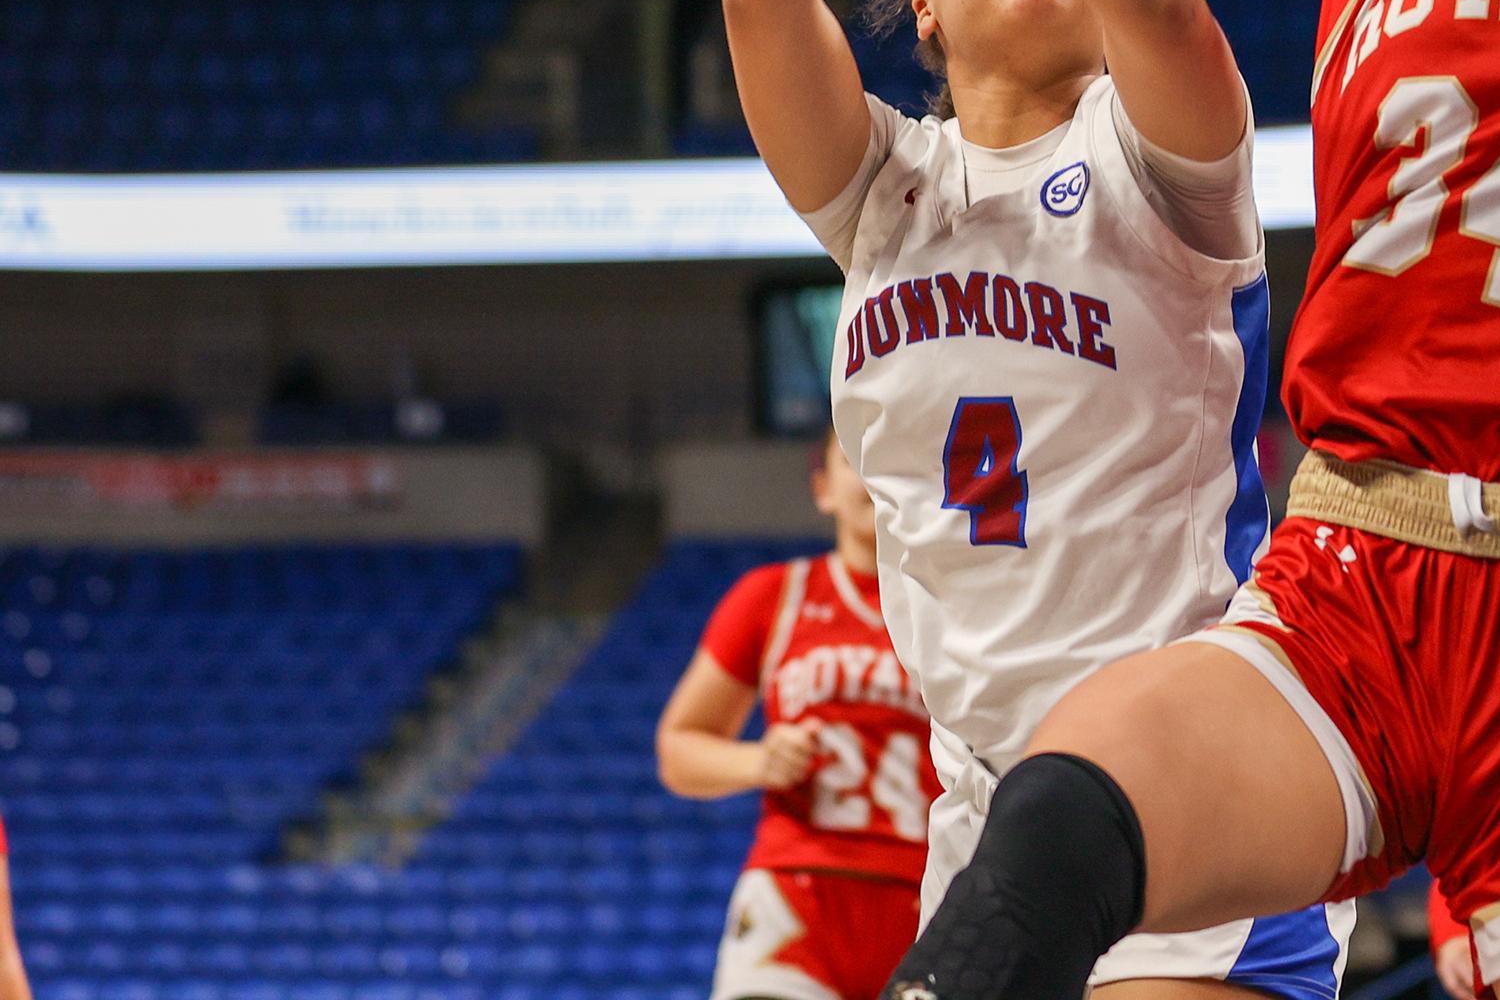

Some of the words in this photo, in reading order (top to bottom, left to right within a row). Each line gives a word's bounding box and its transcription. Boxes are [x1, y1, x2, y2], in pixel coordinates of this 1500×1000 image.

[1051, 172, 1083, 204] SC
[844, 271, 1117, 382] DUNMORE
[940, 396, 1029, 549] 4
[809, 723, 930, 843] 24
